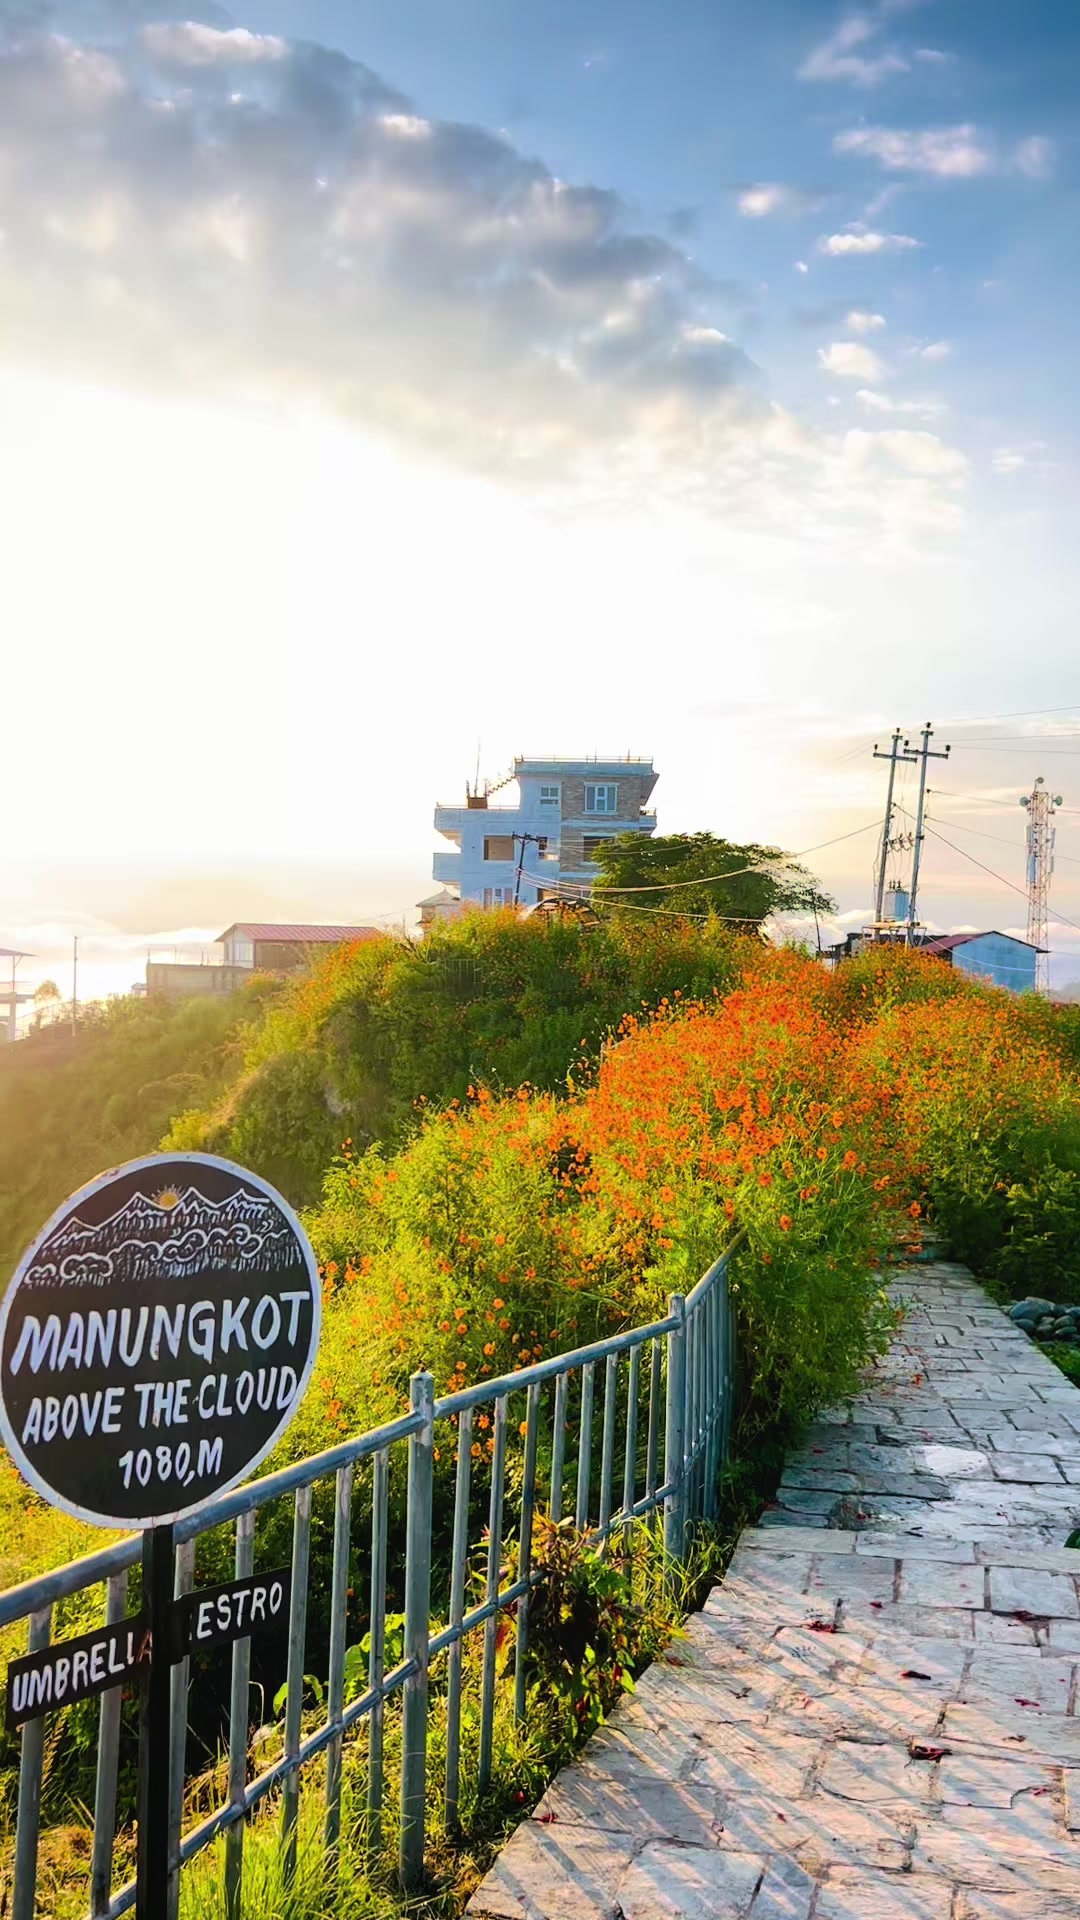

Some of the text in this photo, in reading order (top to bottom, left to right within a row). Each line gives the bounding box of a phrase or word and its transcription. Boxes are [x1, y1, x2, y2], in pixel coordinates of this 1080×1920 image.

[9, 1290, 311, 1376] MANUNGKOT
[21, 1365, 299, 1446] ABOVE THE CLOUD
[188, 1581, 283, 1641] ESTRO
